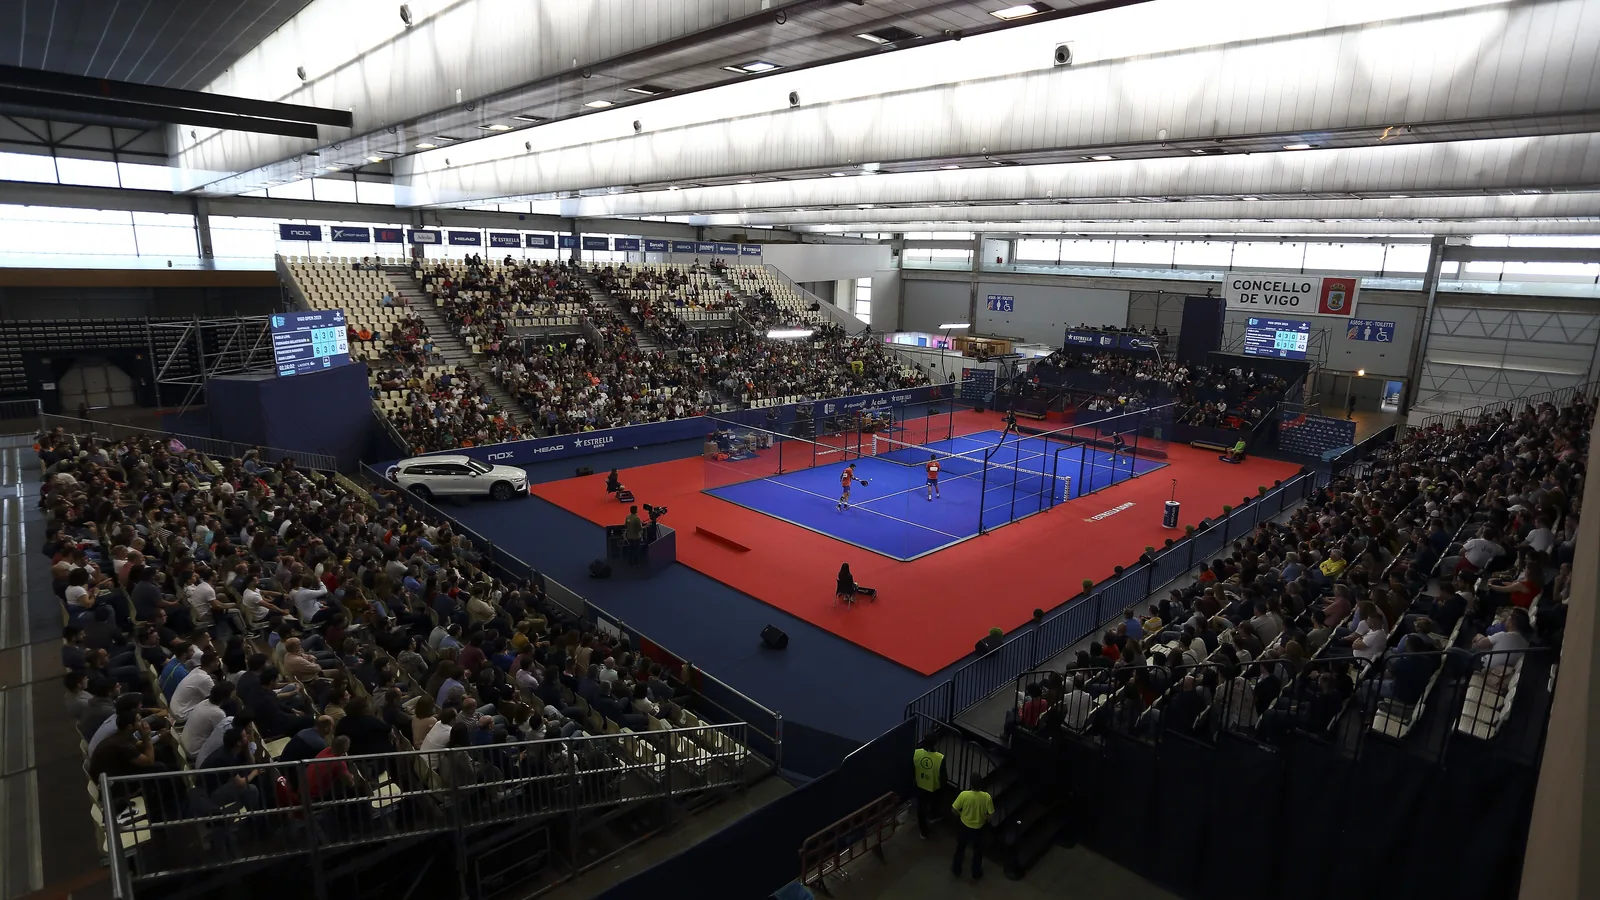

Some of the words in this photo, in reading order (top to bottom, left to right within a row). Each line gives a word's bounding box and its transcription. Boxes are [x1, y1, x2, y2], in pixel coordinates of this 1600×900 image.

[1233, 280, 1311, 293] CONCELLO
[1240, 293, 1258, 303] DE
[1264, 294, 1299, 306] VIGO
[338, 329, 345, 337] 15
[583, 436, 614, 447] ESTRELLA
[533, 445, 564, 454] HEAD
[1091, 505, 1119, 521] ESTRELLA
